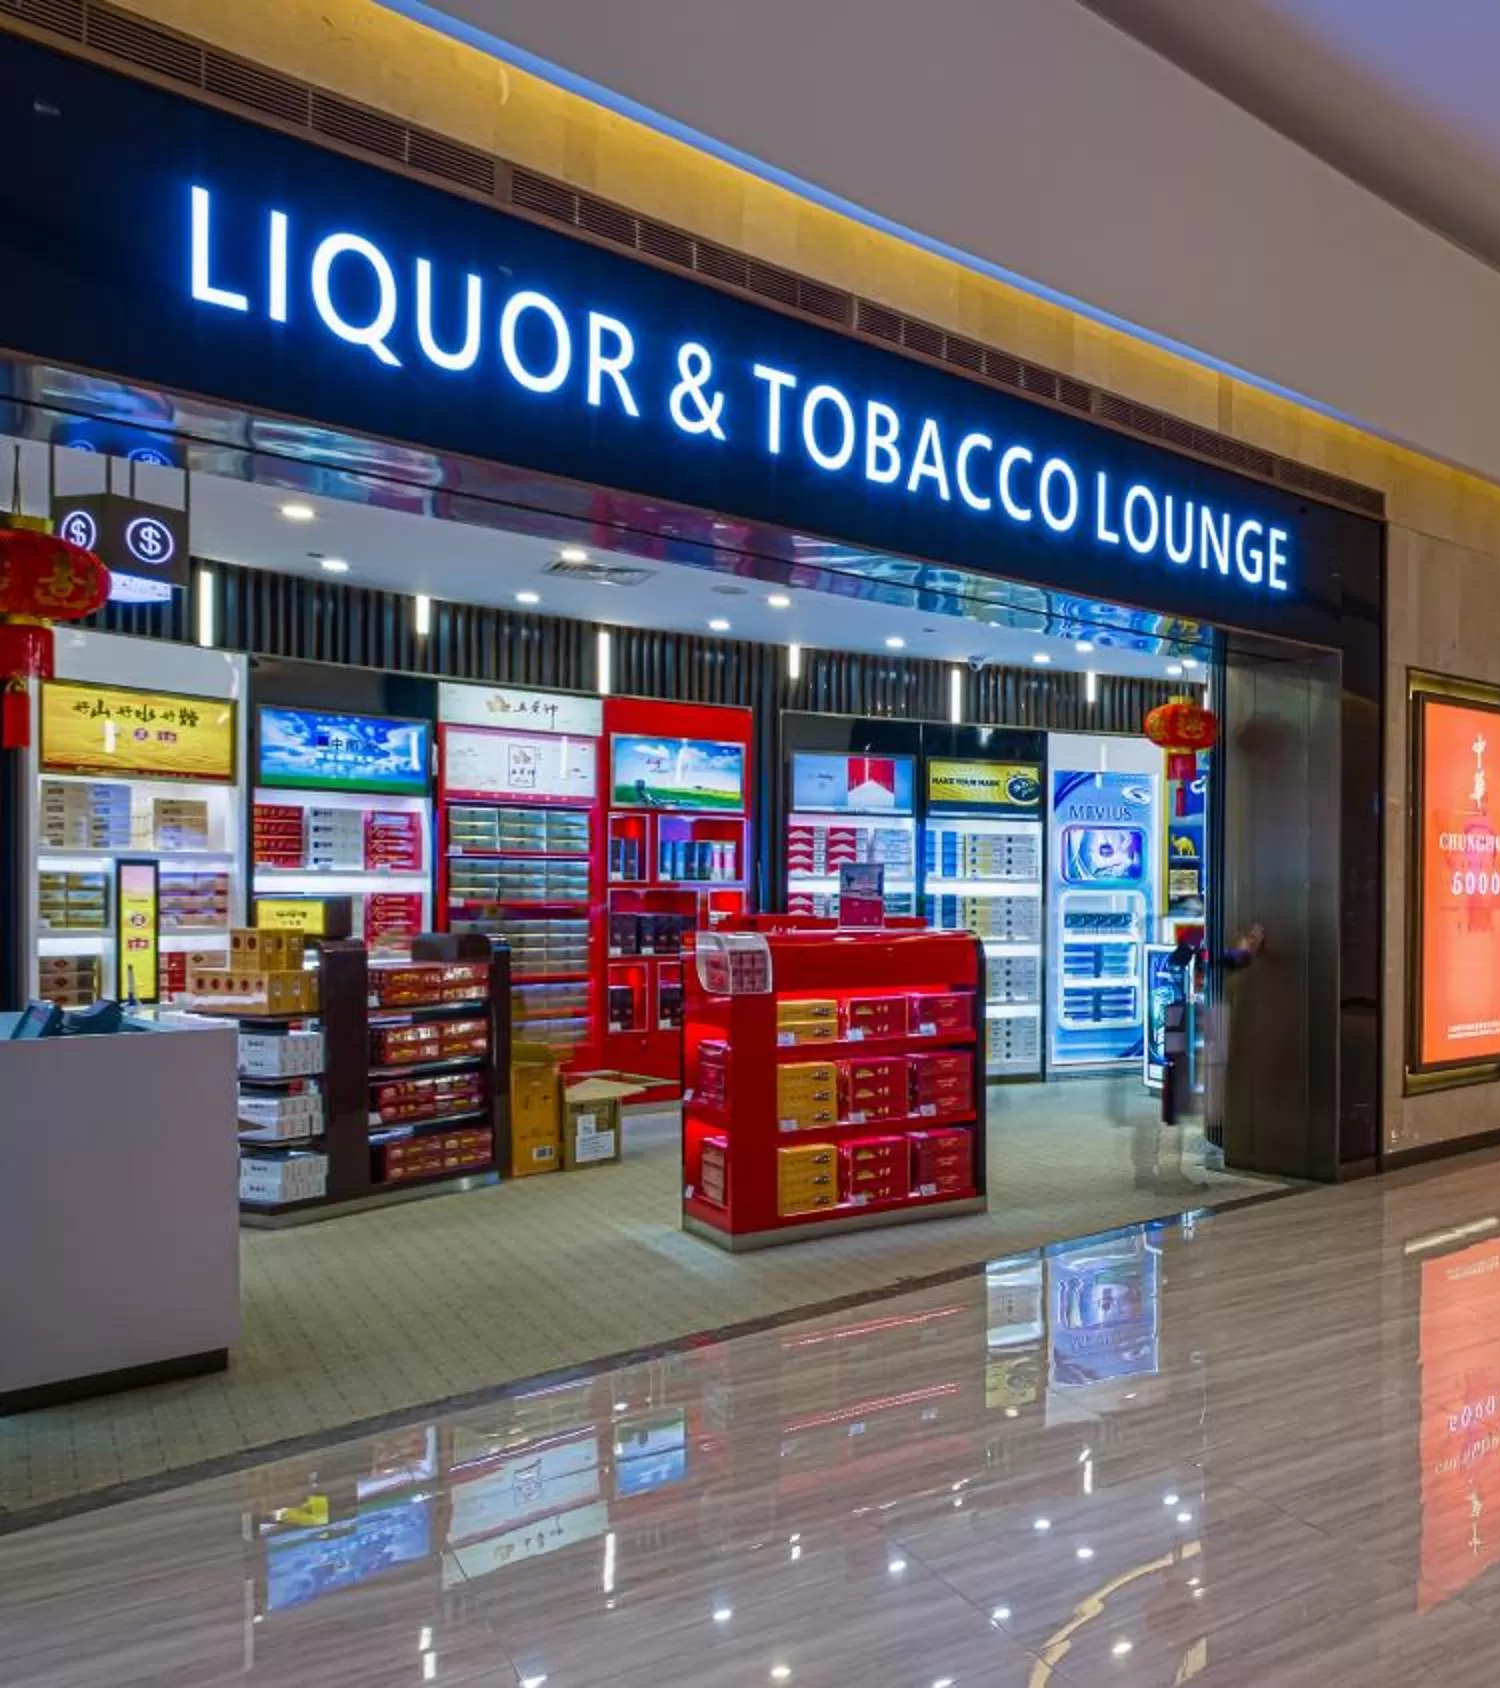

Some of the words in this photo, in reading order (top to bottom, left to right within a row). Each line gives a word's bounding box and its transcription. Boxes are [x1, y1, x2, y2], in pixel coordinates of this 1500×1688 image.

[191, 185, 640, 418] LIQUOR
[669, 342, 727, 440] &
[754, 363, 1079, 532] TOBACCO
[1097, 471, 1288, 590] LOUNGE
[1069, 804, 1133, 821] MEVIUS
